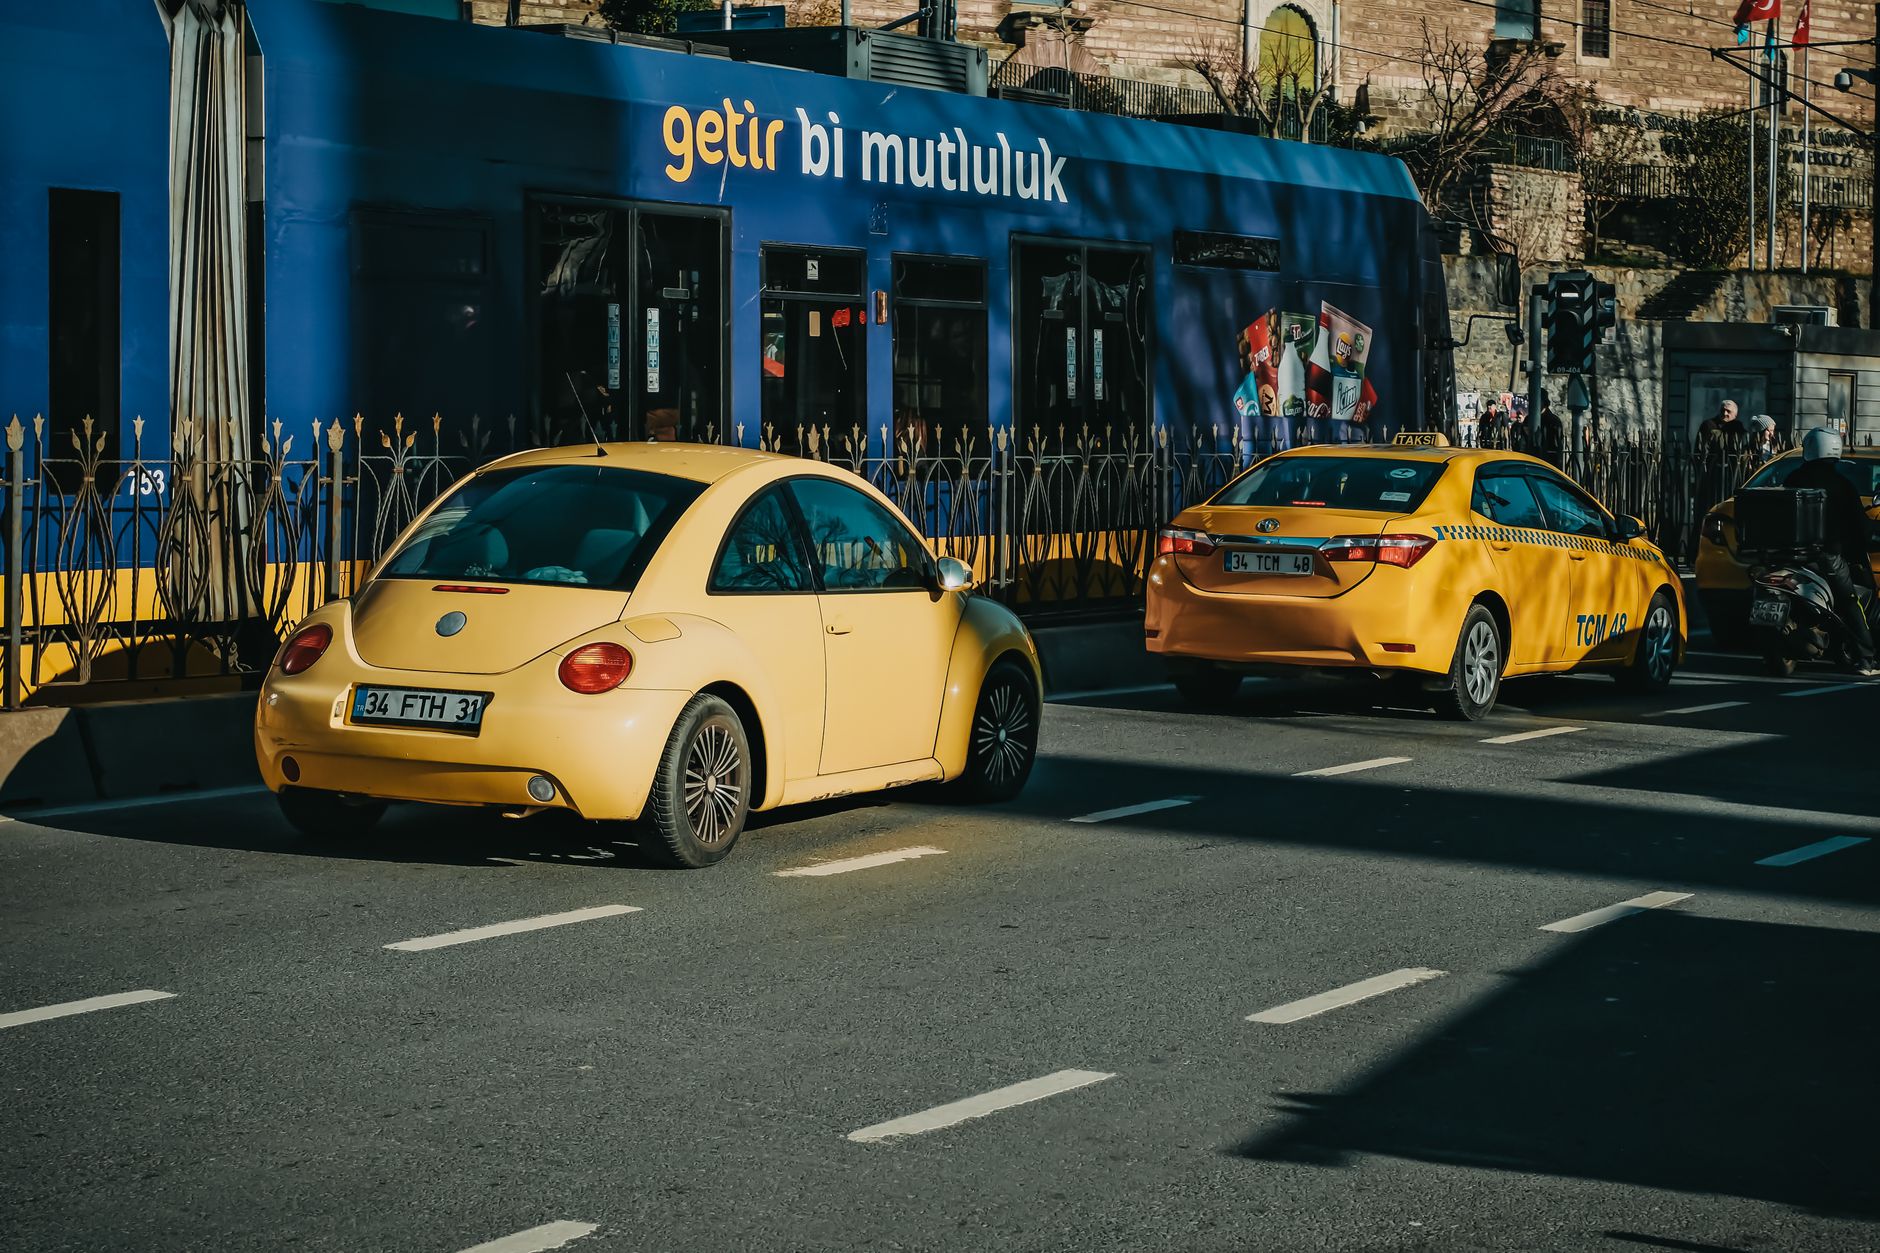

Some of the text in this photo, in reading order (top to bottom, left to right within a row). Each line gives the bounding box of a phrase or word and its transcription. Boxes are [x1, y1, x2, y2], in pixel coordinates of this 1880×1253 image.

[662, 97, 1068, 203] getir bi mutluluk
[127, 469, 165, 495] 753
[1233, 554, 1310, 572] 34 TCM 48
[1576, 612, 1627, 647] TCM 48
[365, 692, 389, 715] 34
[400, 694, 447, 718] FTH
[455, 698, 479, 721] 31
